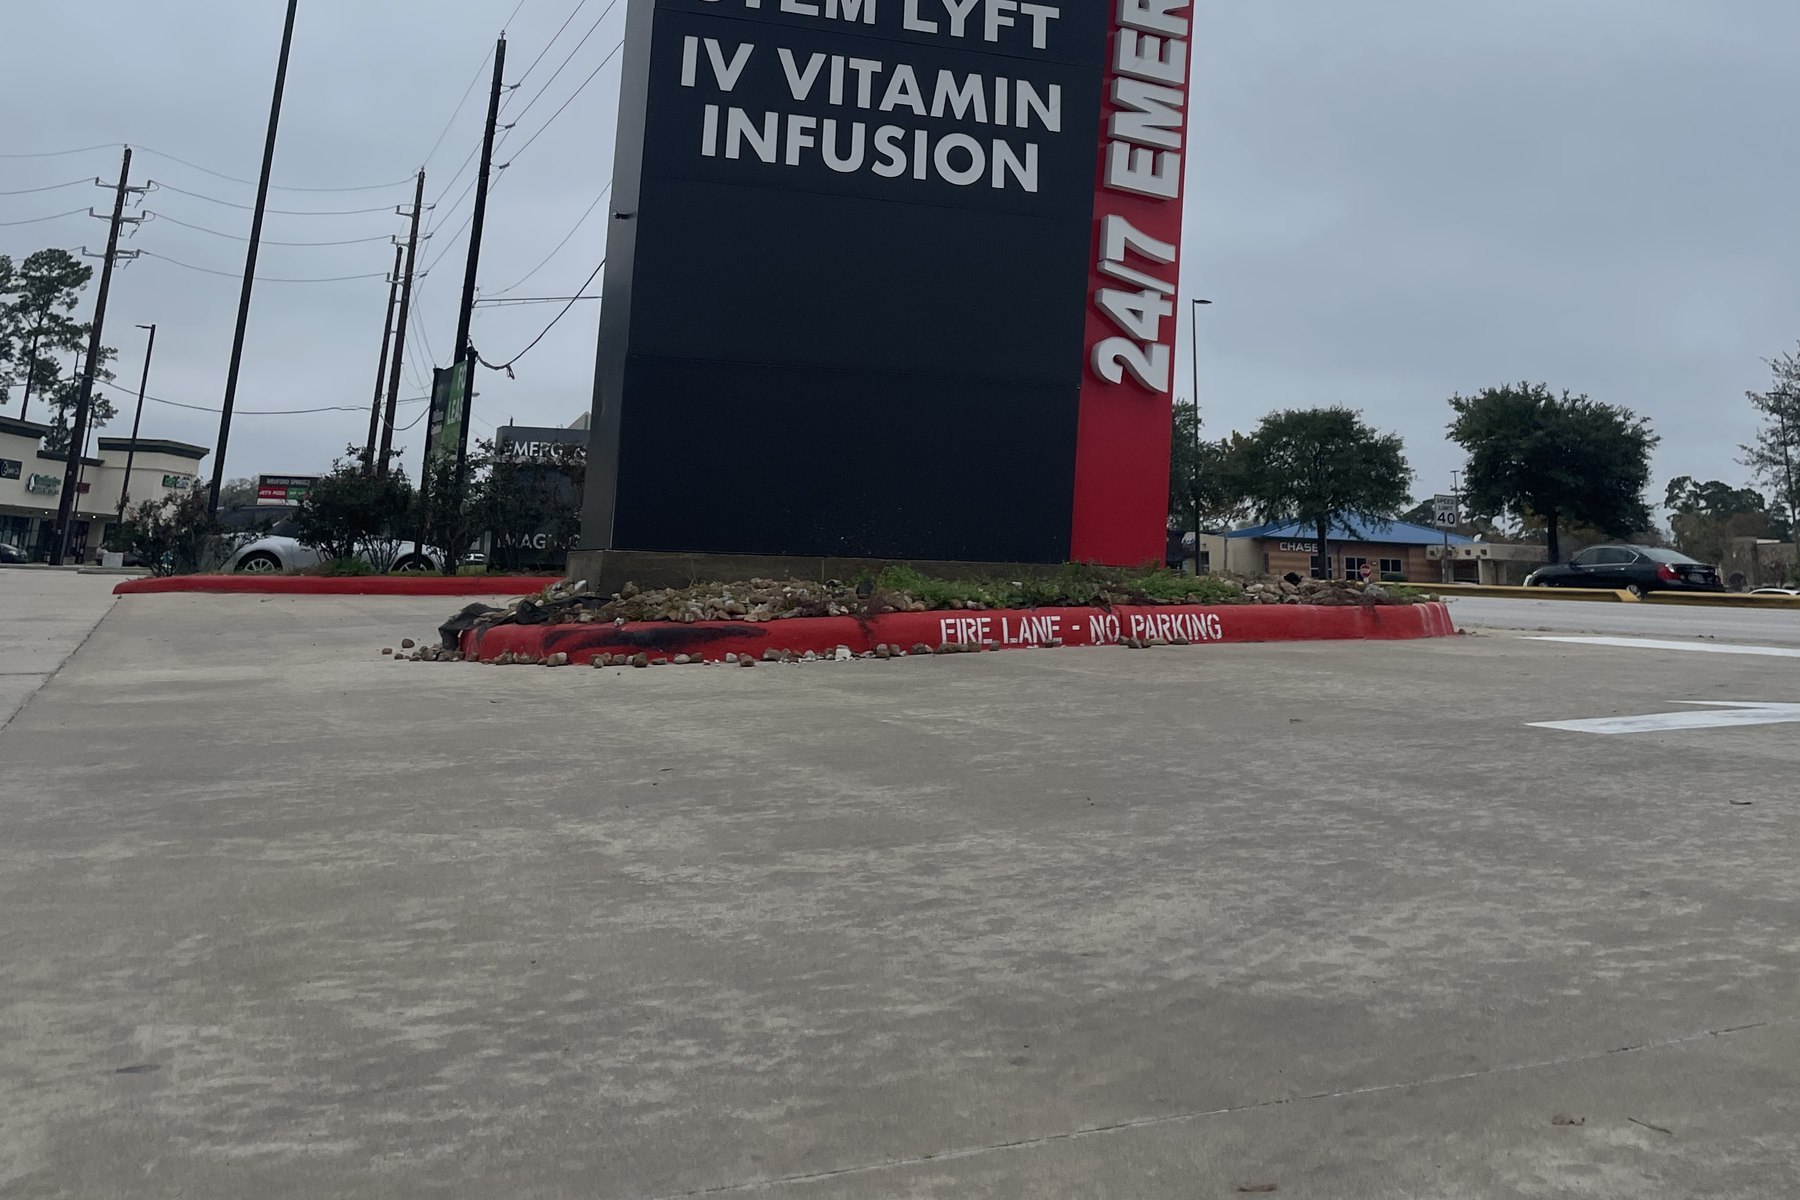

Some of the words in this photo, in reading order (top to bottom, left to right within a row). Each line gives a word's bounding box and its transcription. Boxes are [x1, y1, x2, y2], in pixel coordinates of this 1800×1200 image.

[680, 35, 755, 92] IV
[777, 47, 1061, 133] VITAMIN
[701, 104, 1039, 193] INFUSION
[1092, 214, 1176, 395] 24/7
[1280, 541, 1318, 554] CHASE
[1437, 511, 1455, 525] 40
[940, 617, 993, 645] FIRE
[1002, 615, 1062, 644] LANE
[1089, 614, 1120, 643] NO
[1130, 613, 1222, 641] PARKING
